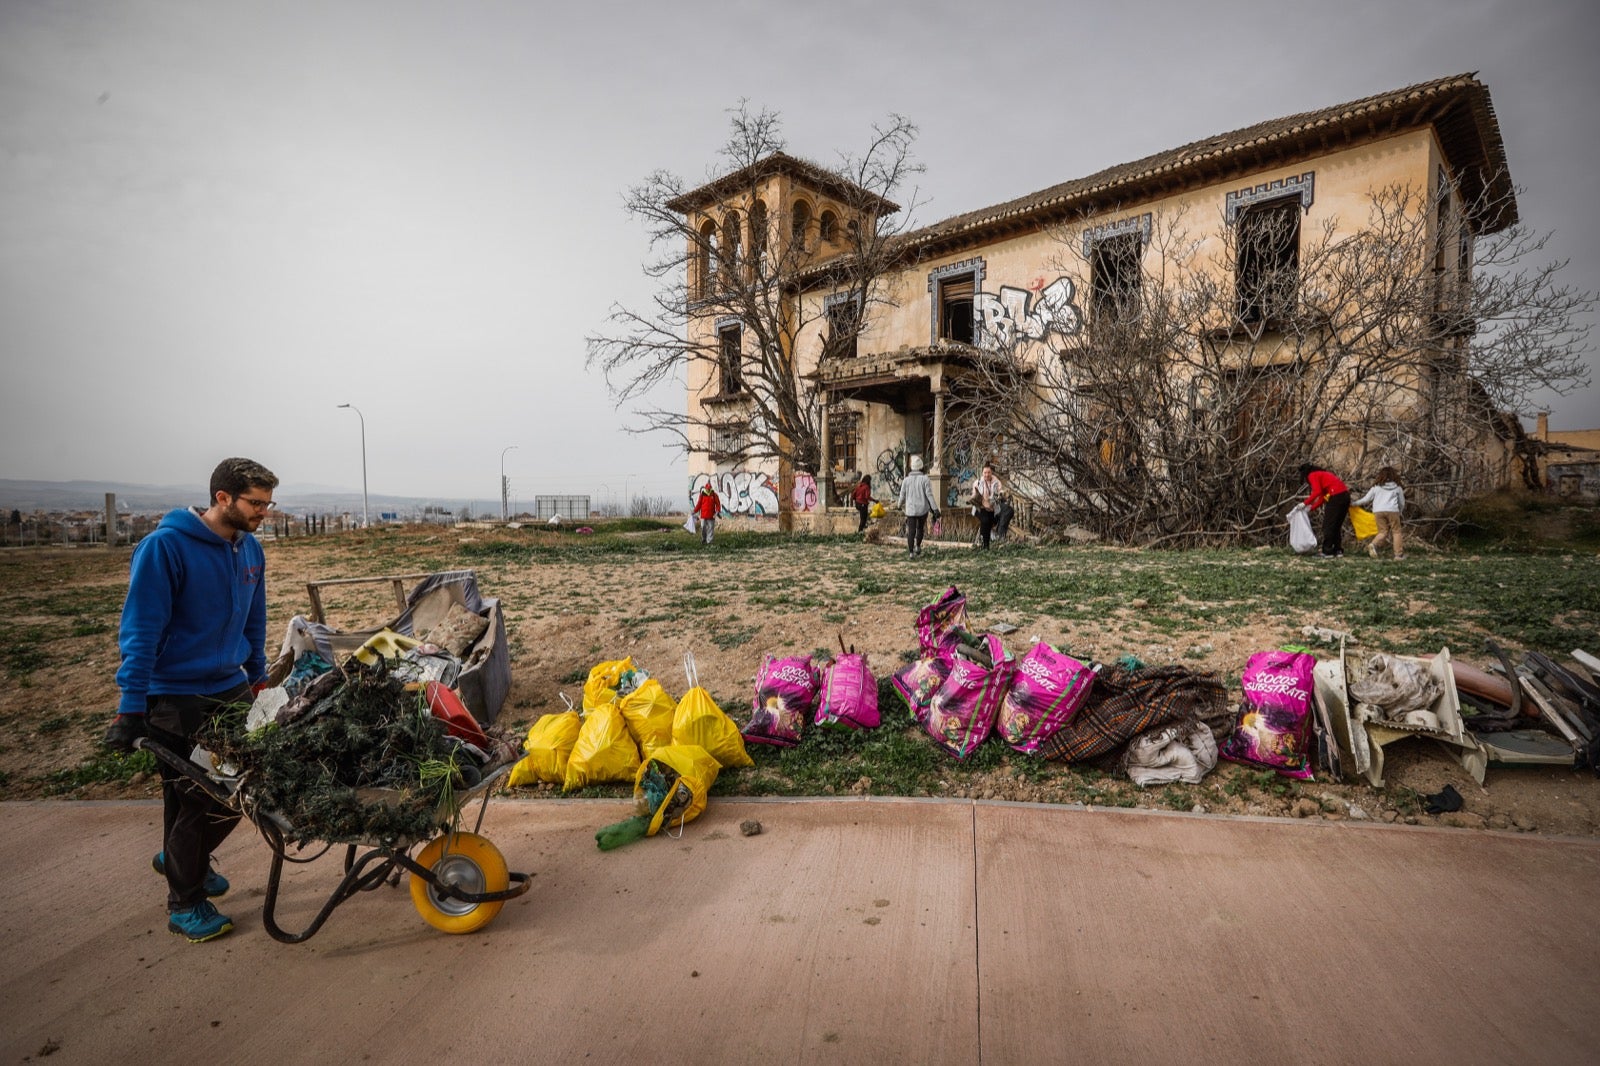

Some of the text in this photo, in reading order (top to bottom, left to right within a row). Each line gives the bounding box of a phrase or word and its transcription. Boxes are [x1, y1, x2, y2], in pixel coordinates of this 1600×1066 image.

[782, 665, 810, 680] COCOS
[1024, 658, 1052, 677] COCOS
[1256, 671, 1299, 686] COCOS
[1244, 682, 1309, 701] SUBSTRATE
